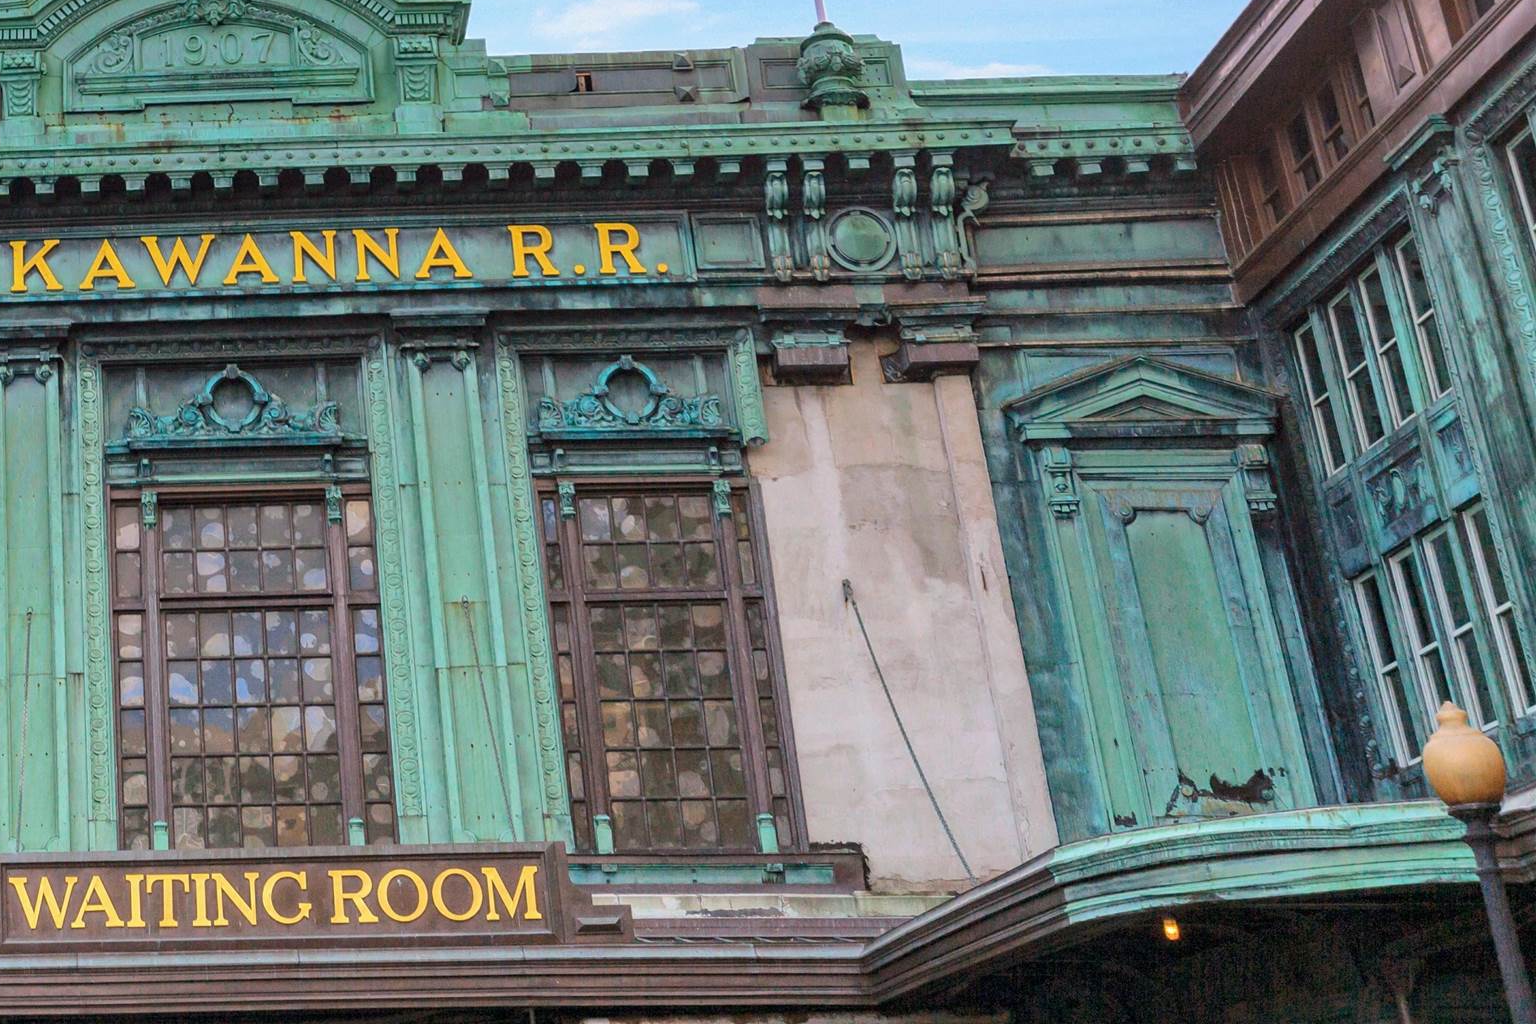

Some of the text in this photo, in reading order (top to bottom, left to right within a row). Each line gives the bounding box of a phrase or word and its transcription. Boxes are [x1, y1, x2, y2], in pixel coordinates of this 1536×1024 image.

[163, 31, 275, 67] 1907
[507, 222, 670, 278] R.R.
[8, 865, 543, 930] WAITING ROOM
